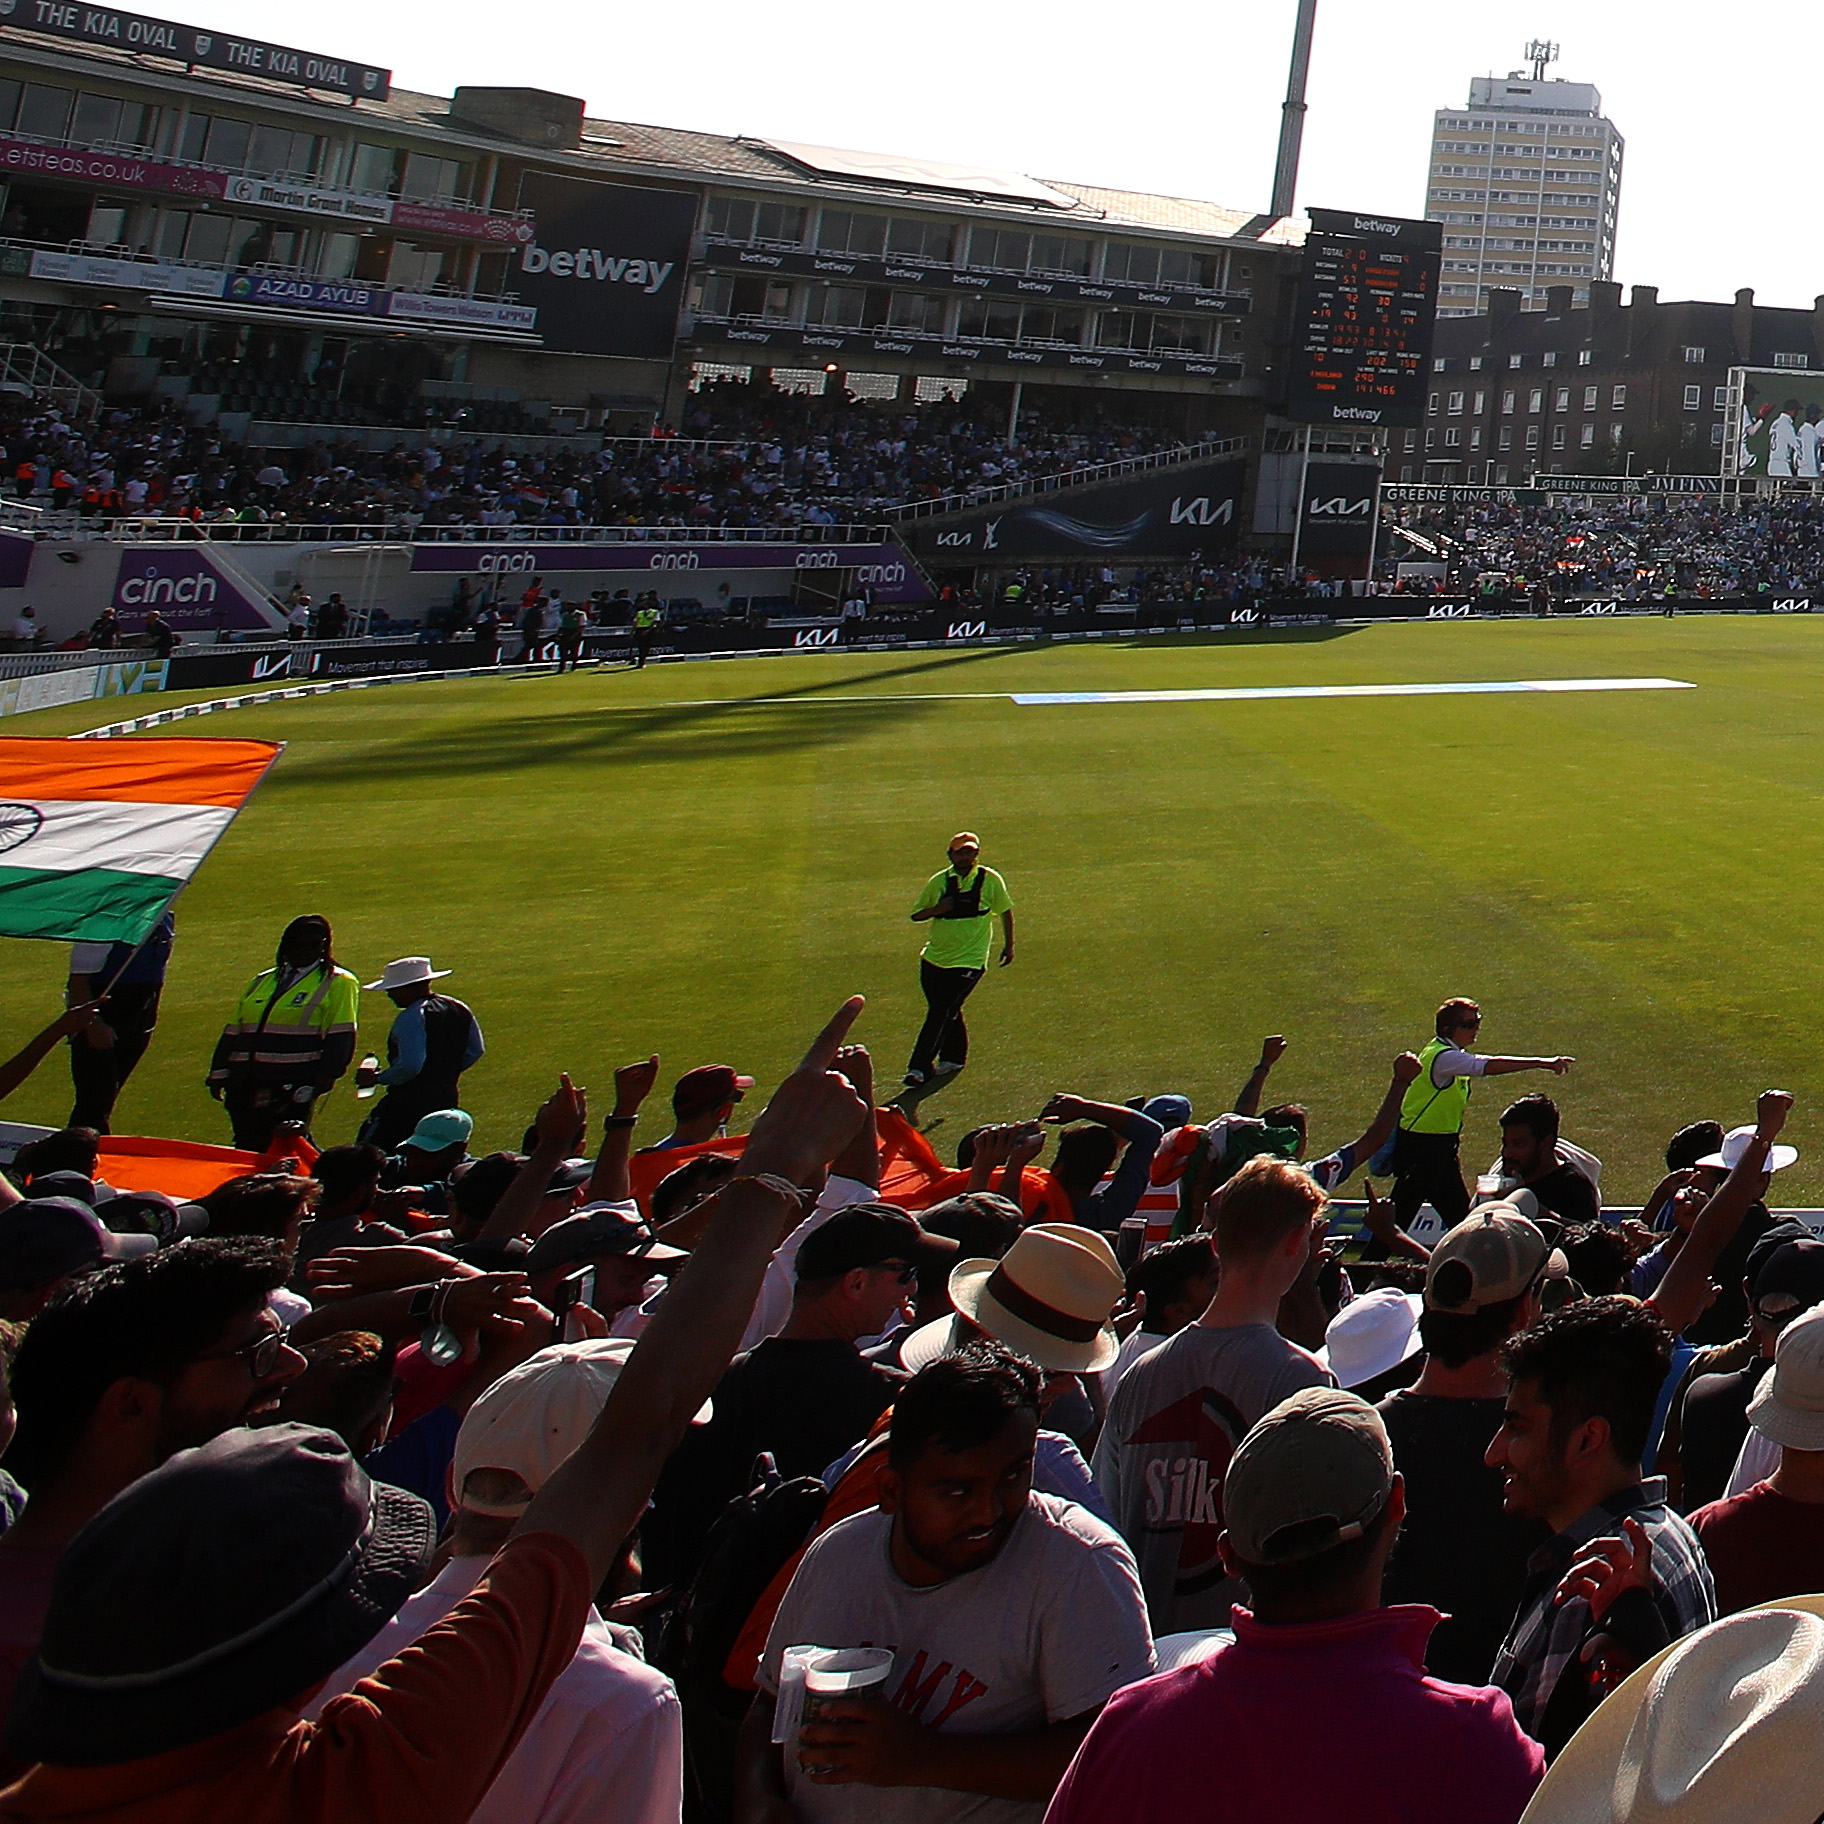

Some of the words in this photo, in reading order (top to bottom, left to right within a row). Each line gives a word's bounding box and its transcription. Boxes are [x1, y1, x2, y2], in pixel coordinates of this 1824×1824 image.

[36, 0, 78, 29] THE
[84, 11, 120, 39] KIA
[128, 21, 178, 51] OVAL
[226, 41, 262, 69] THE
[268, 51, 299, 77] KIA
[305, 59, 349, 87] OVAL
[0, 146, 147, 184] .etsteas.co.uk
[1354, 217, 1401, 236] betway
[740, 251, 784, 267] betway
[1322, 247, 1344, 257] TOTAL
[522, 240, 674, 293] betway
[815, 258, 855, 274] betway
[886, 266, 924, 281] betway
[953, 273, 991, 288] betway
[1018, 279, 1053, 294] betway
[256, 280, 313, 299] AZAD
[318, 287, 370, 305] AYUB
[1079, 286, 1113, 300] betway
[1138, 291, 1172, 305] betway
[1195, 296, 1226, 309] betway
[727, 328, 771, 344] betway
[803, 335, 844, 350] betway
[874, 340, 914, 354] betway
[942, 345, 980, 359] betway
[1007, 350, 1043, 364] betway
[1070, 354, 1104, 367] betway
[1129, 358, 1161, 372] betway
[1185, 362, 1217, 376] betway
[1333, 406, 1382, 423] betway
[1542, 479, 1586, 491] GREENE
[1590, 480, 1618, 491] KING
[1622, 480, 1641, 493] IPA
[1652, 478, 1676, 491] JM
[1387, 488, 1447, 502] GREENE
[1452, 489, 1491, 502] KING
[1496, 488, 1518, 503] IPA
[1170, 497, 1233, 526] KIA
[1310, 497, 1371, 515] KIA
[937, 532, 971, 546] KIA
[480, 546, 536, 573] cinch
[650, 547, 699, 570] cinch
[121, 567, 217, 604] cinch
[1429, 604, 1470, 618] KIA
[1581, 601, 1617, 614] KIA
[1773, 598, 1809, 610] KIA
[947, 621, 986, 638] KIA
[794, 628, 839, 647] KIA
[329, 660, 375, 674] Movement
[378, 660, 393, 671] that
[396, 658, 429, 673] inspires
[1146, 1457, 1220, 1524] Silk
